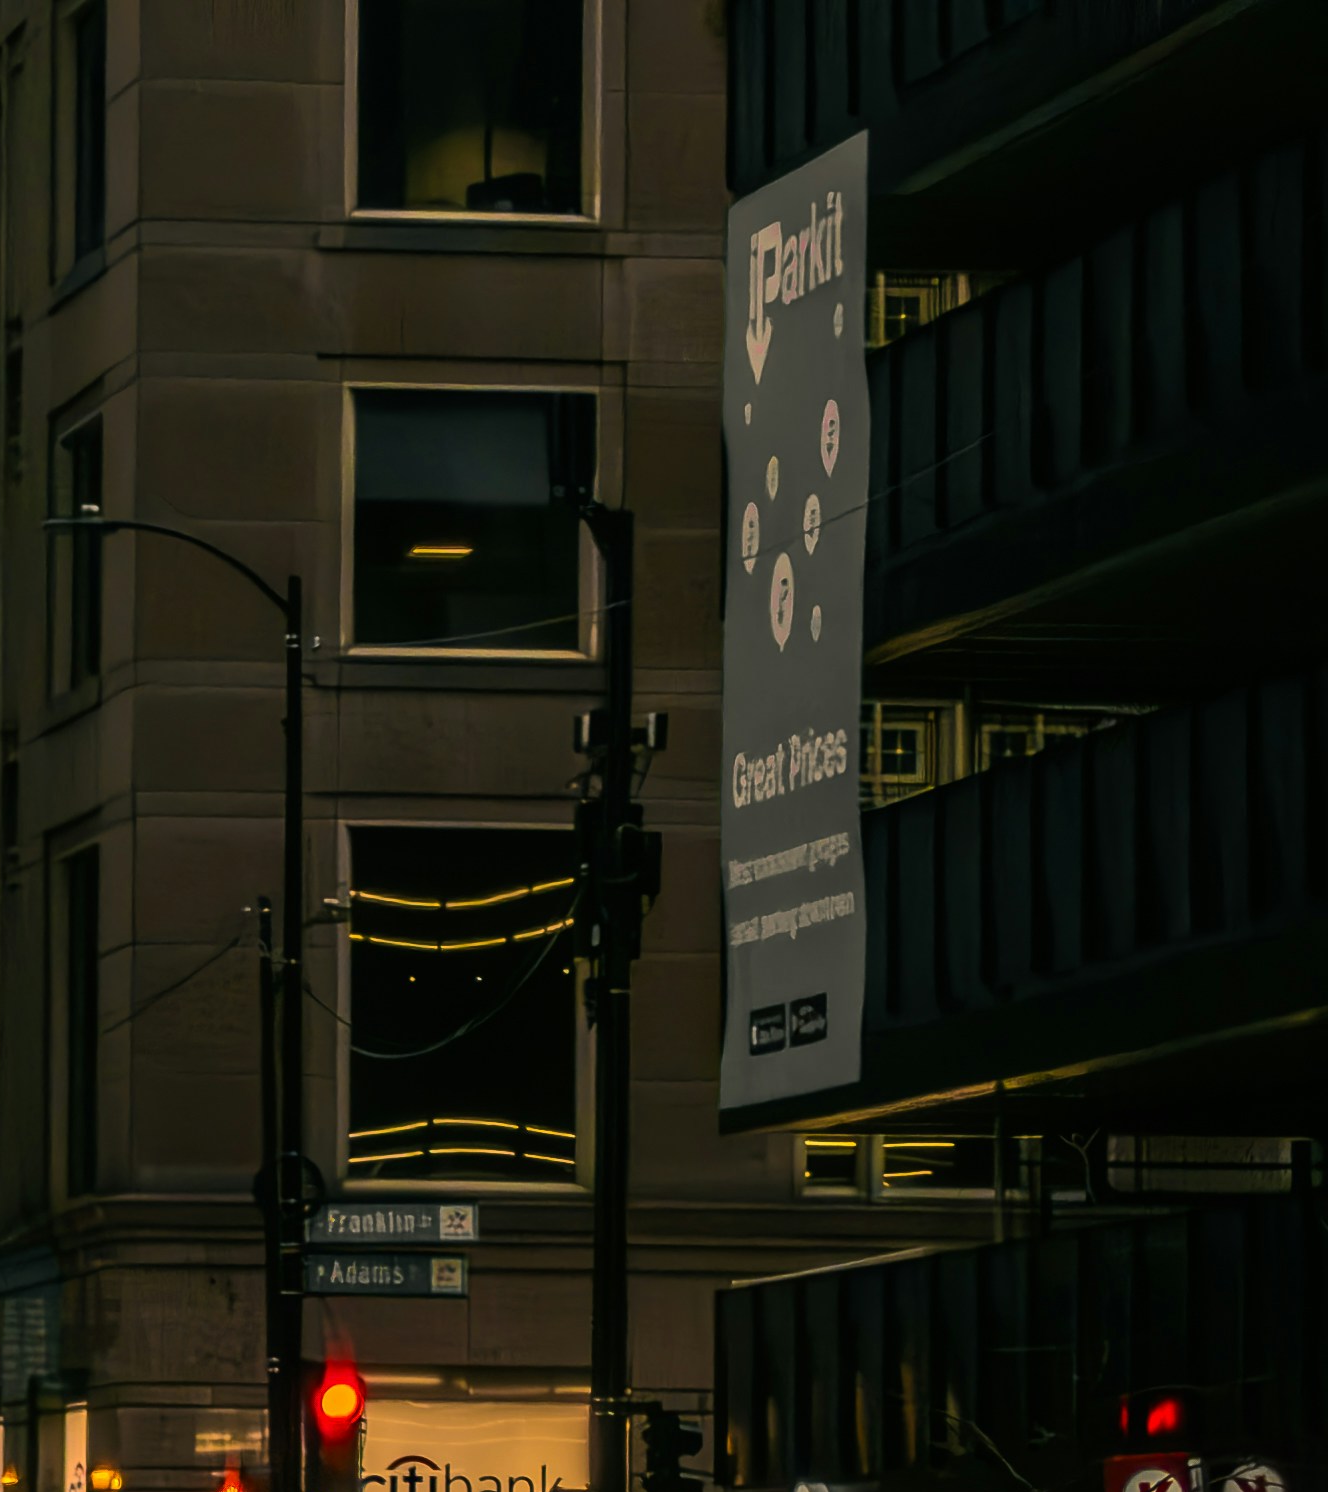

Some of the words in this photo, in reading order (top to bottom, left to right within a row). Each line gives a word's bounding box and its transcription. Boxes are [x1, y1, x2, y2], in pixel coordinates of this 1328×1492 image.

[732, 751, 785, 808] Great
[788, 727, 848, 792] Prices
[327, 1208, 416, 1234] Franklin
[329, 1260, 405, 1285] Adams
